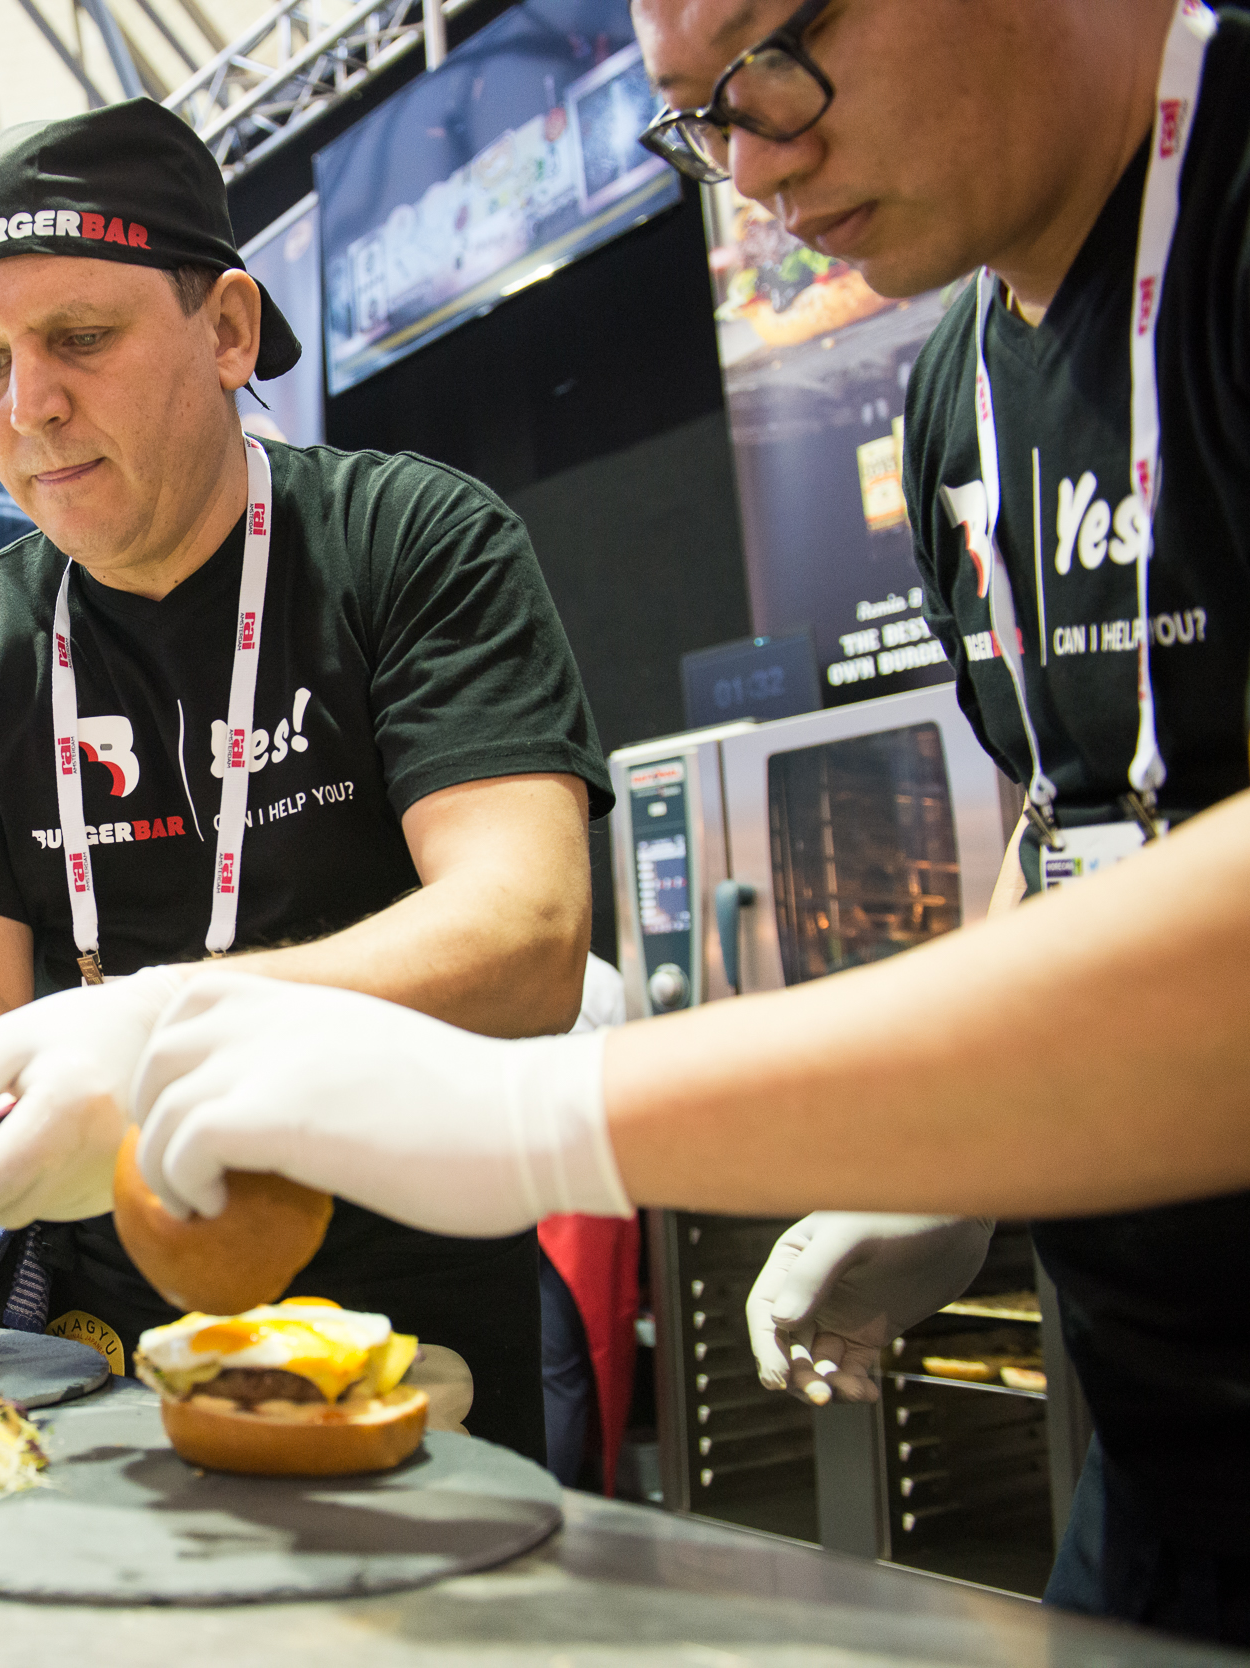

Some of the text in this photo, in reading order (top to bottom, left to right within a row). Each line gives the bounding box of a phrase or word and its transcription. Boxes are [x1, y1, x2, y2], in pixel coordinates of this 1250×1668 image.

[241, 612, 256, 650] rai
[1053, 624, 1086, 656] CAN
[1090, 623, 1097, 652] I
[1151, 606, 1207, 647] OU?
[57, 736, 73, 775] rai
[70, 735, 78, 775] AMSTERDAM
[226, 729, 234, 769] AMSTERDAM
[231, 728, 245, 768] rai
[213, 780, 355, 833] CN I HELP YOU?
[32, 815, 186, 850] BUGERBAR
[69, 852, 86, 893] rai
[81, 851, 91, 892] AMSTERDAM
[216, 852, 224, 894] AMSTERDAM
[220, 852, 235, 894] rai
[51, 1318, 117, 1355] WAGYU
